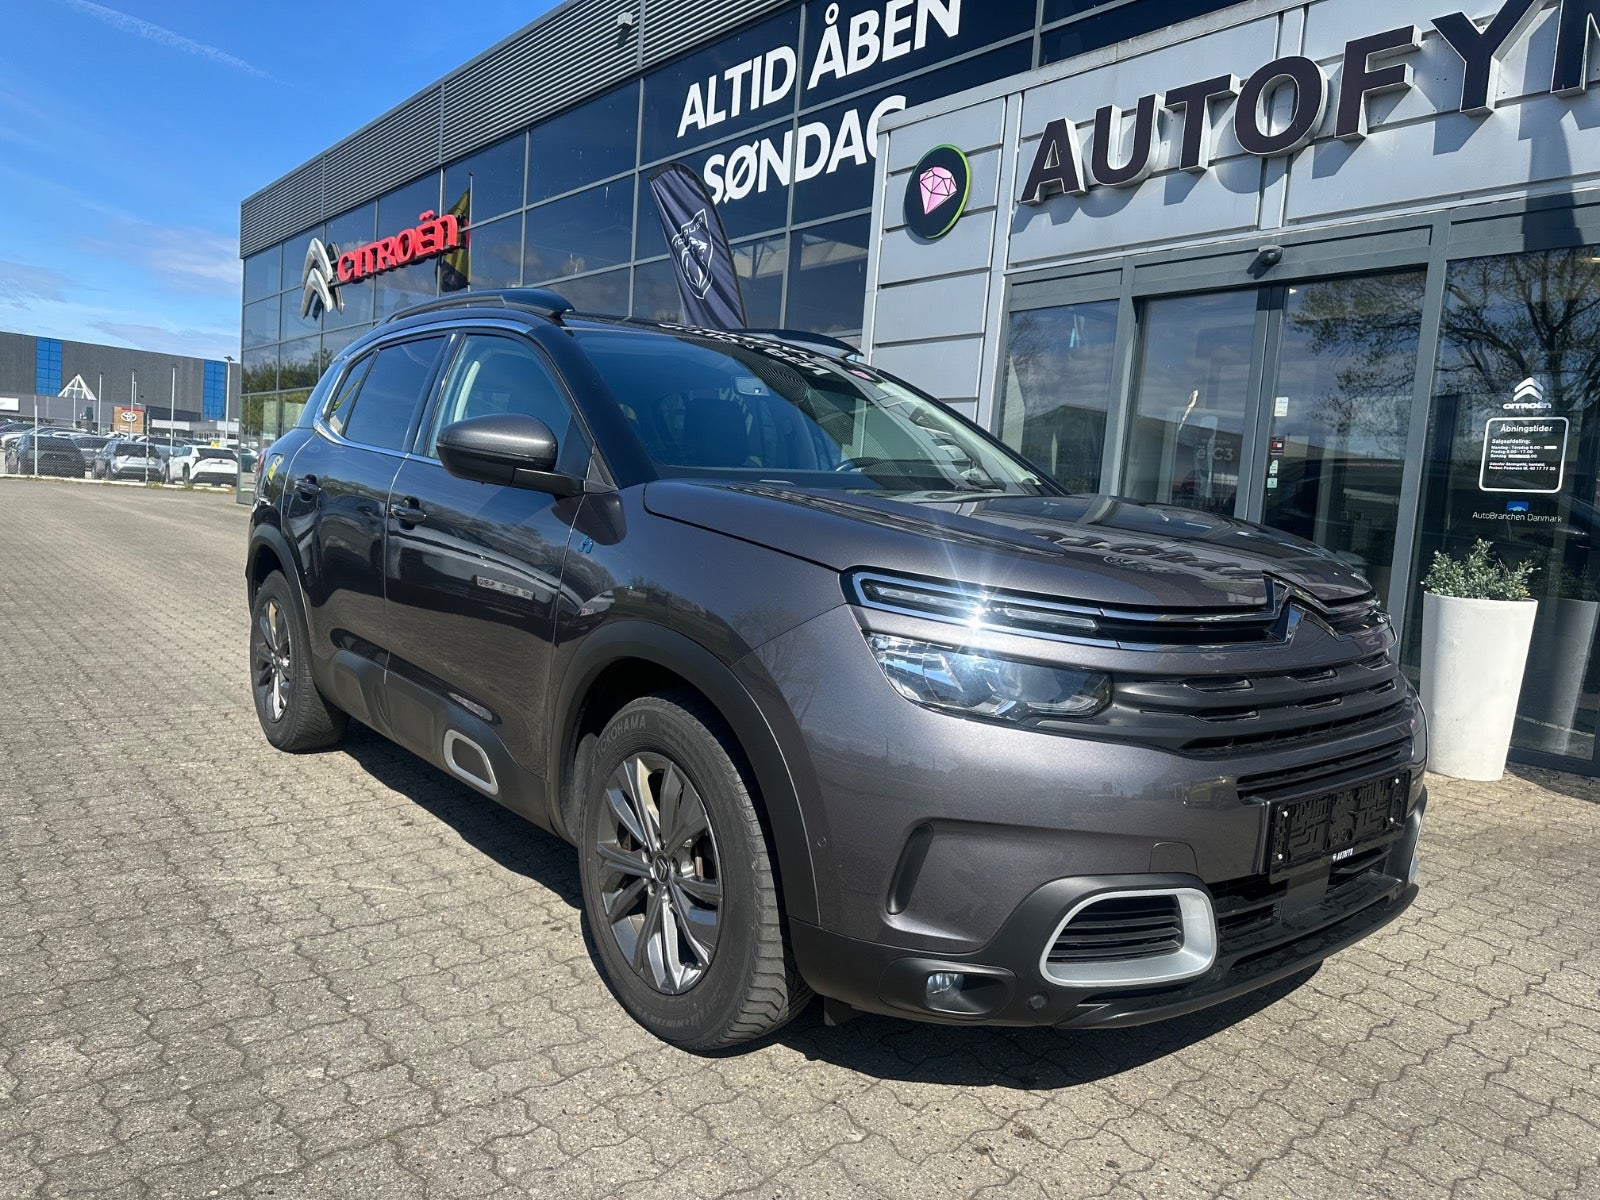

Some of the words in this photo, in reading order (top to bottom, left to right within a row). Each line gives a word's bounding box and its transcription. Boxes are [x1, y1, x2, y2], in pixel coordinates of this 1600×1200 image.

[676, 46, 798, 138] ALTID
[807, 0, 961, 90] ÅBEN
[337, 209, 459, 282] CITROËN
[1500, 423, 1553, 433] Åbningstider
[1472, 511, 1526, 521] AutoBranchen
[1527, 513, 1563, 523] Danmark
